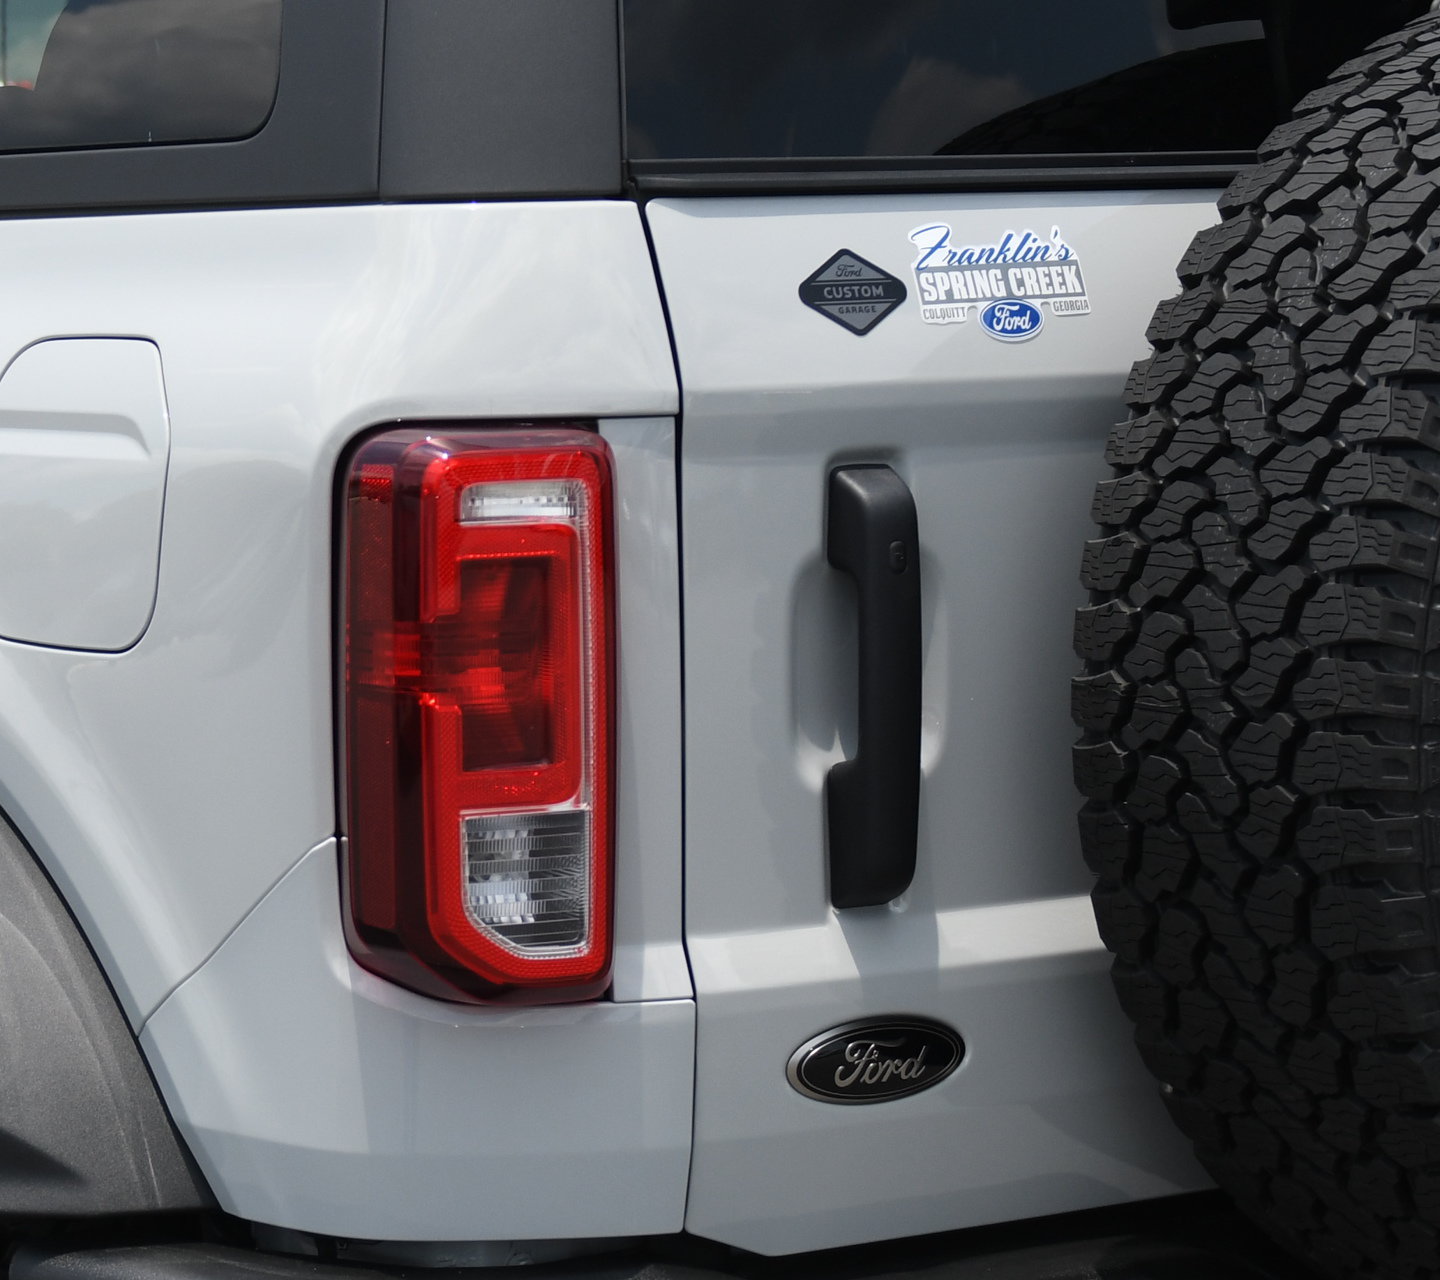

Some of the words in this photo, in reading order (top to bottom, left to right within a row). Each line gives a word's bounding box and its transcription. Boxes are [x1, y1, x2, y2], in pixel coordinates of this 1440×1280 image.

[909, 224, 1074, 271] Franklin's
[834, 263, 863, 278] Ford
[921, 269, 1007, 302] SPRING
[1012, 264, 1082, 297] CREEK
[823, 284, 884, 300] CUSTOM
[837, 304, 877, 316] GARAGE
[922, 306, 967, 321] COLQUITT
[1052, 299, 1090, 313] GEORGIA
[992, 303, 1032, 332] Ford
[834, 1037, 927, 1088] Ford
